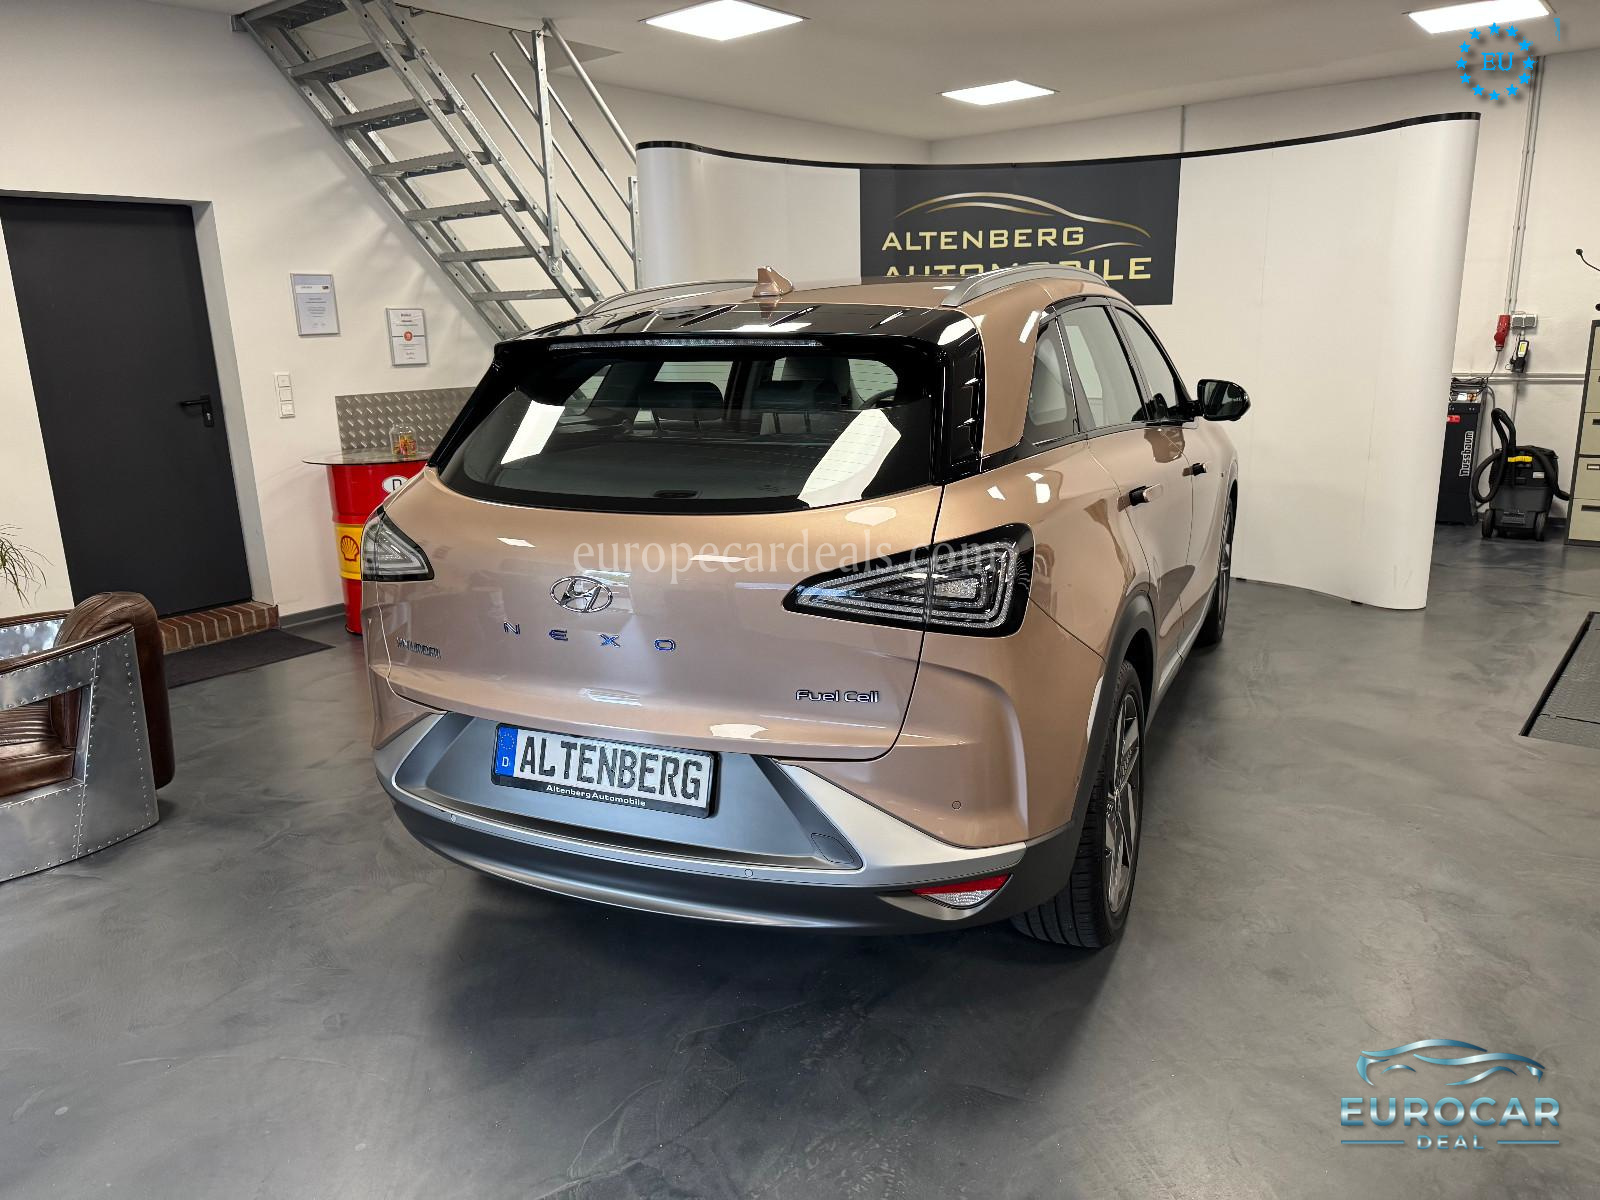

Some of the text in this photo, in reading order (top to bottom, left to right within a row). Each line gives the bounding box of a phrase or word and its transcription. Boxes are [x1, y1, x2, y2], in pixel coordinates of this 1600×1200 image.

[881, 227, 1084, 251] ALTENBERG
[503, 622, 676, 651] NEXO
[795, 689, 880, 703] Fuel Cell
[501, 756, 510, 767] D
[519, 736, 703, 801] ALTENBERG
